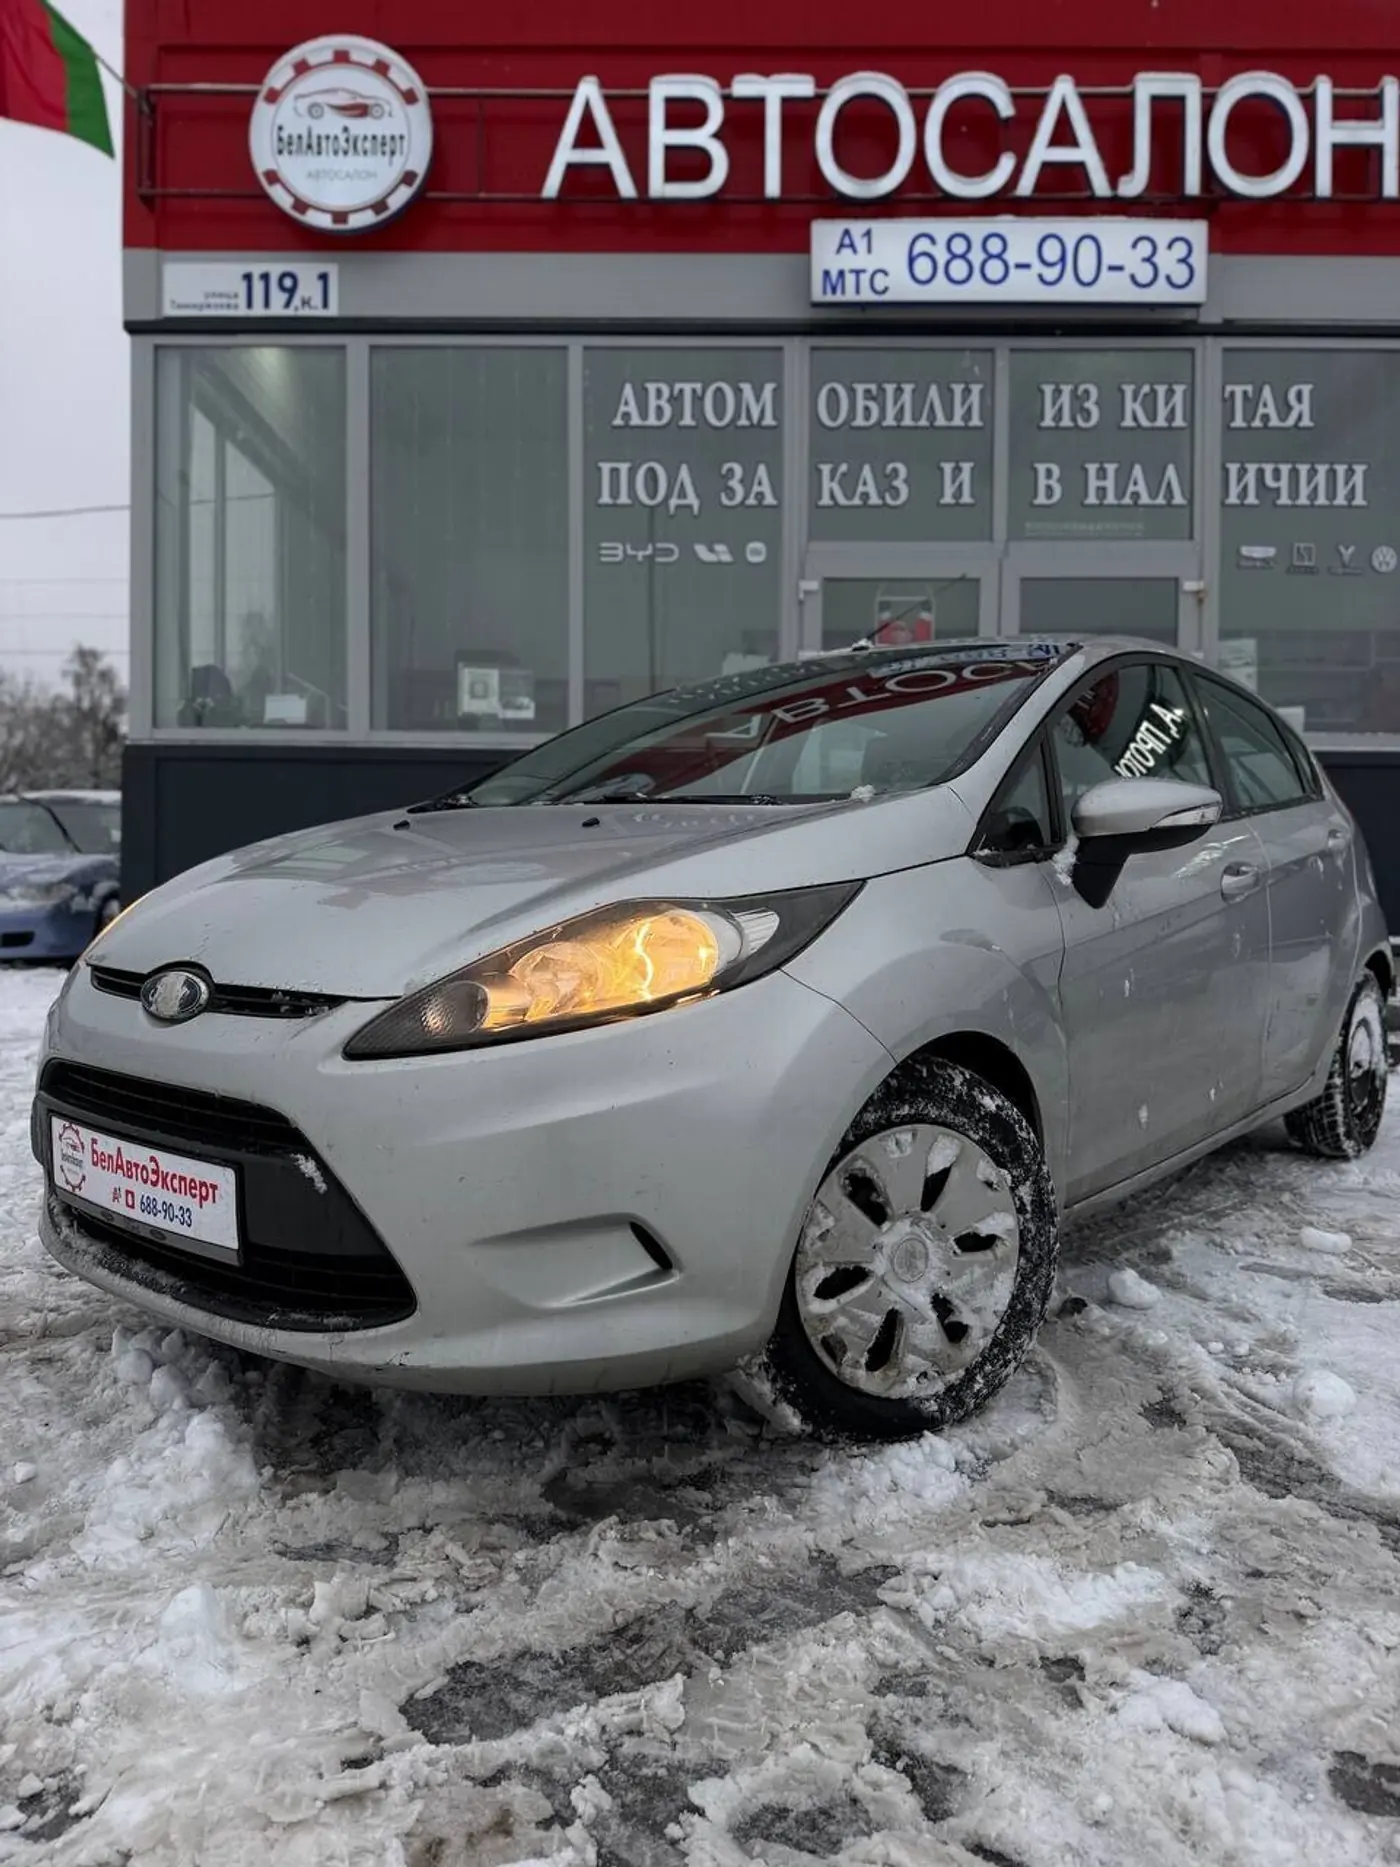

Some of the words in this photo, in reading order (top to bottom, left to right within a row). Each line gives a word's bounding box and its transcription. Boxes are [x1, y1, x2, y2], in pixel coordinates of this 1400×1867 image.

[276, 124, 406, 167] БелАвтоЭксперт
[541, 70, 1400, 199] АВТОСАЛОН
[836, 228, 874, 256] A1
[907, 231, 1196, 289] 688-90-33
[821, 268, 890, 297] МТС
[1039, 383, 1100, 429] ИЗ
[1120, 383, 1188, 429] КИ
[1225, 384, 1315, 429] ТАЯ
[597, 461, 700, 516] ПОД
[939, 461, 975, 504] И
[1033, 463, 1062, 505] В
[600, 542, 679, 562] BYD
[91, 1137, 218, 1208] БелАвтоЭксперт
[140, 1194, 192, 1228] 688-90-33
